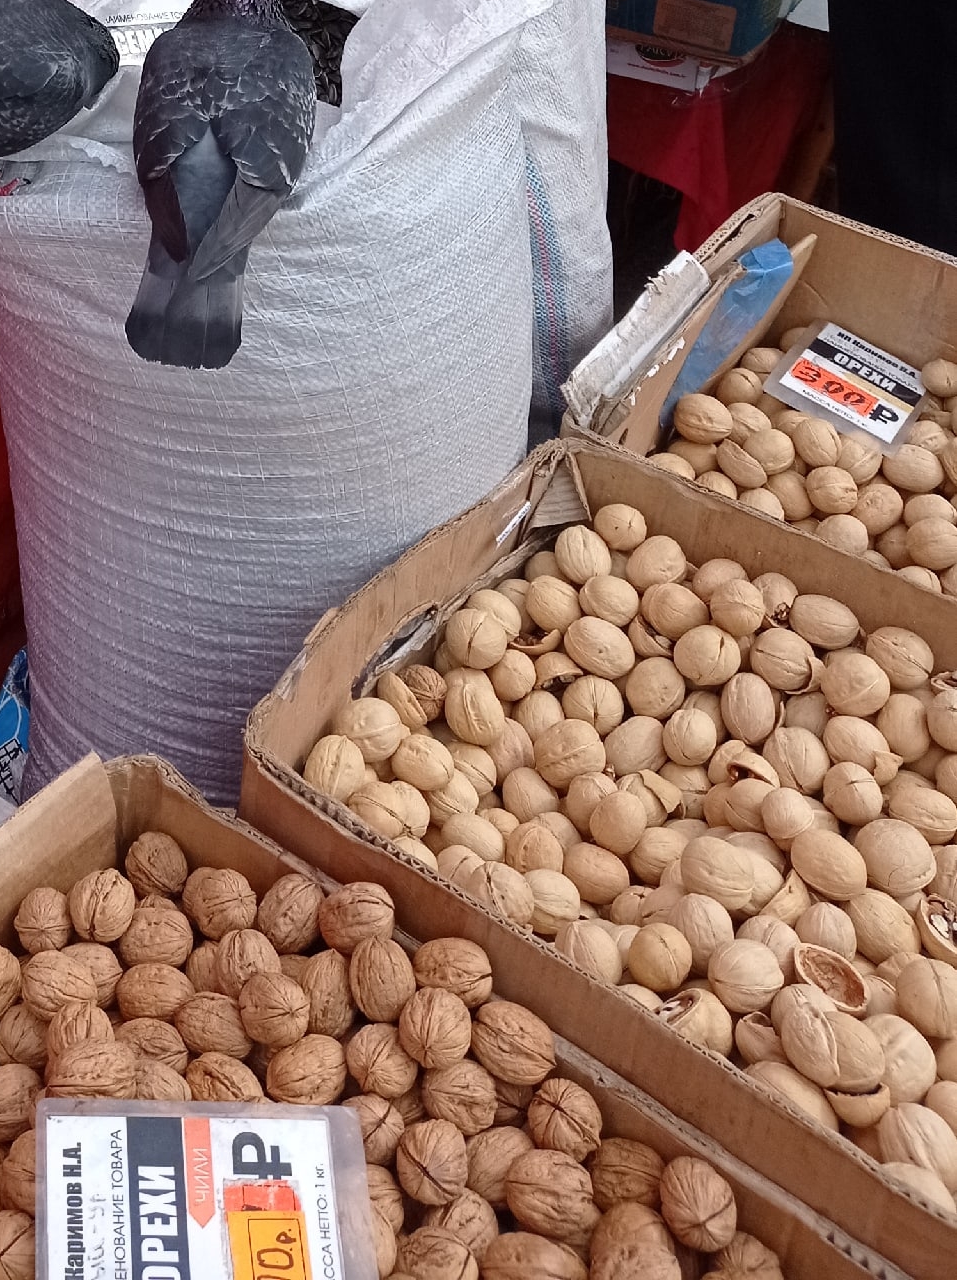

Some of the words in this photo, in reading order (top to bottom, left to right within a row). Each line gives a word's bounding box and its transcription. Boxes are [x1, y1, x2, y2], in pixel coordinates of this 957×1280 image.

[833, 352, 897, 393] ОРЕХИ
[62, 1141, 82, 1178] Н.А.
[110, 1129, 125, 1191] ТОВАРА
[194, 1148, 209, 1204] ЧИЛИ
[112, 1195, 128, 1280] ЕНОВАНИЕ
[315, 1193, 332, 1240] НЕТТО:
